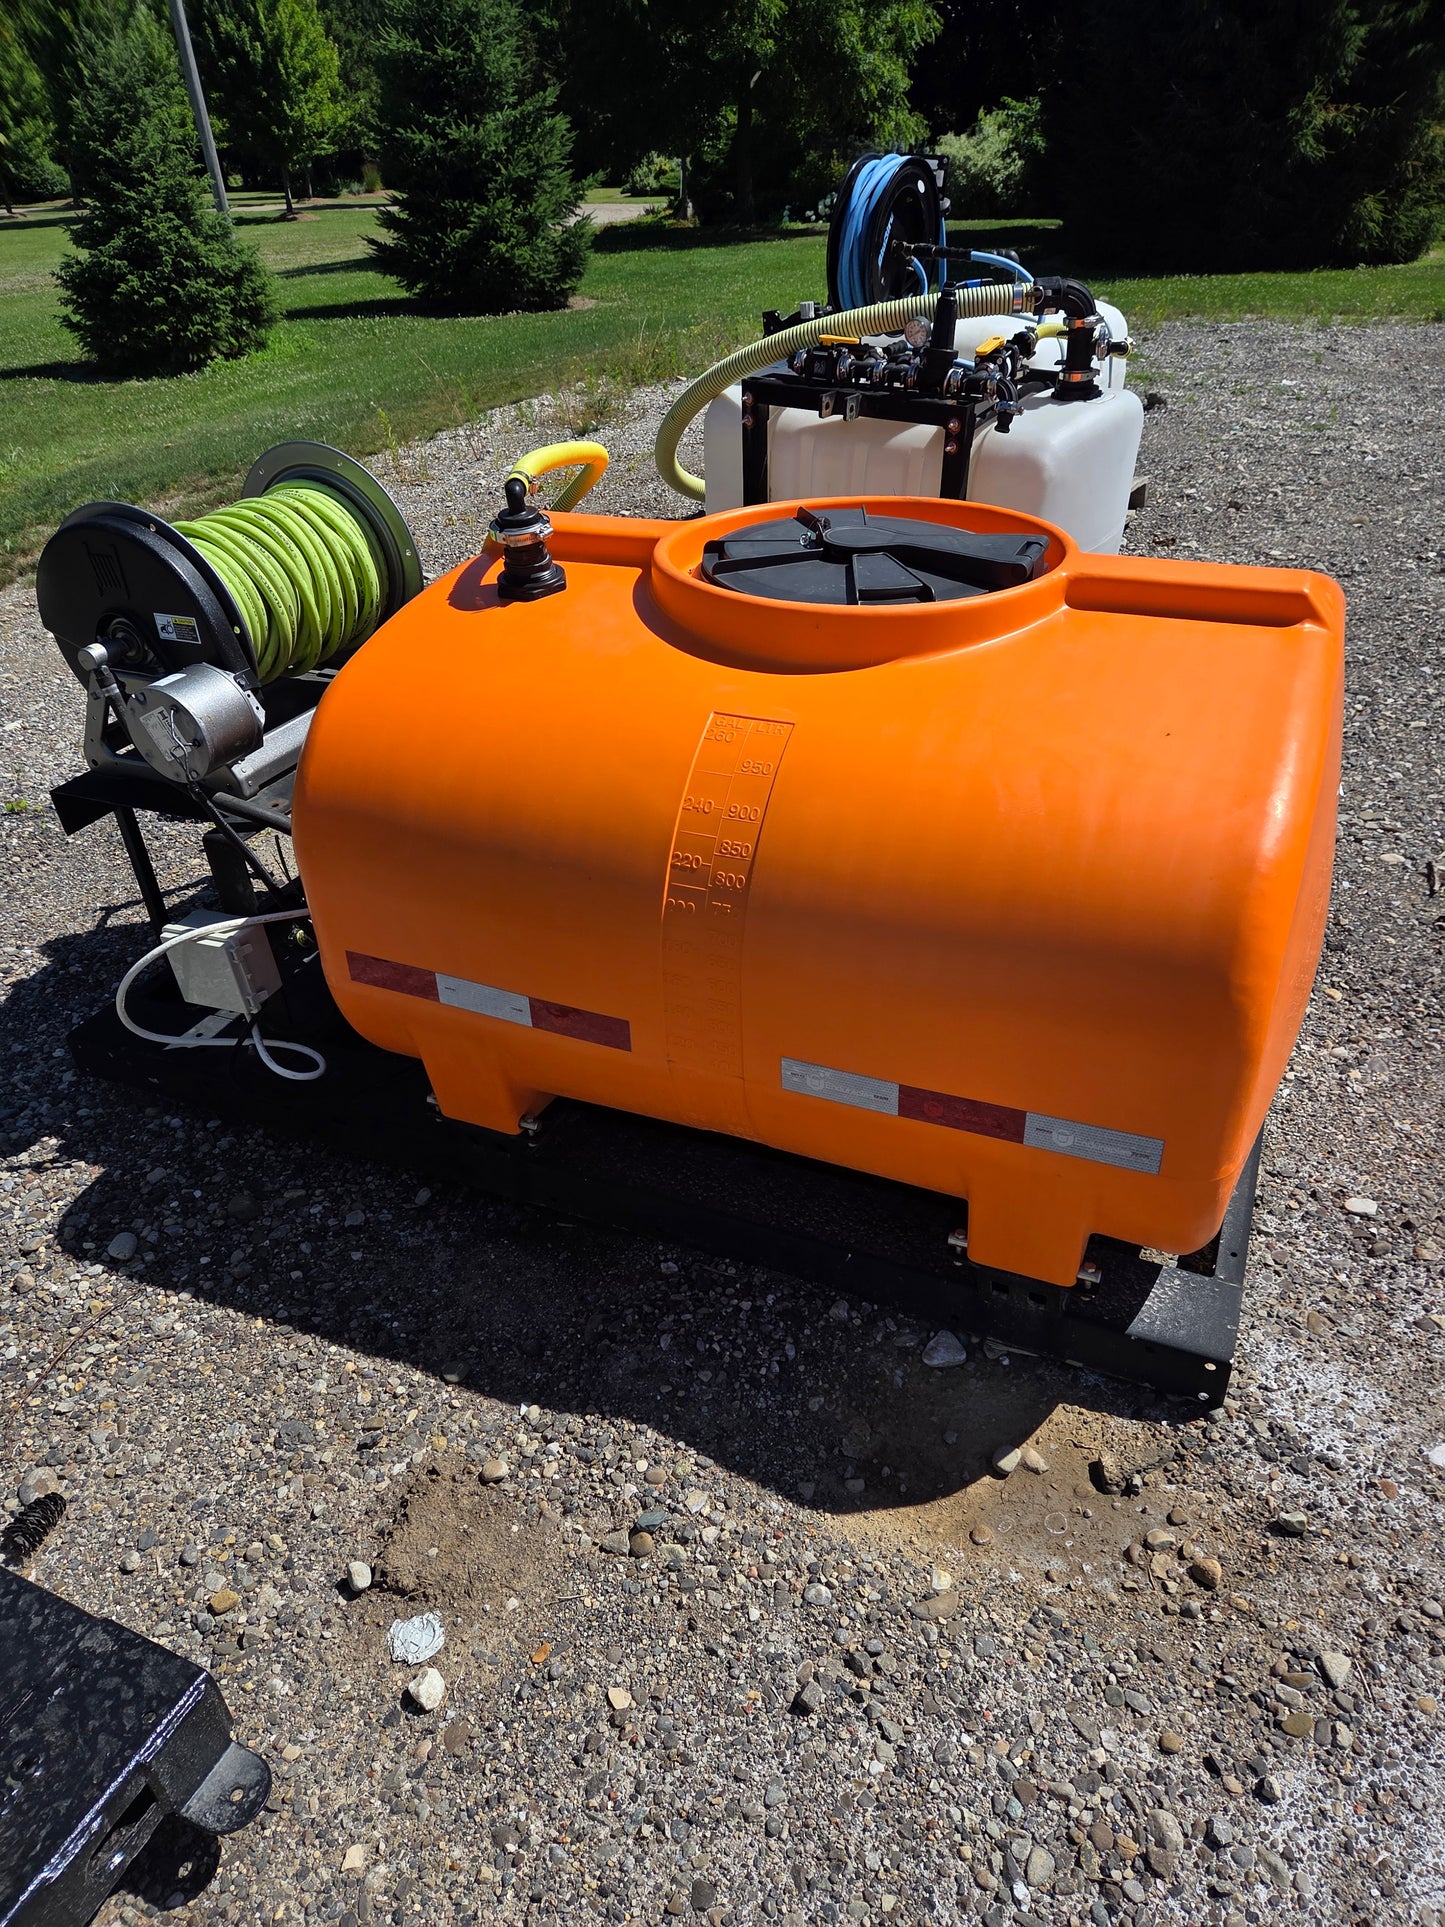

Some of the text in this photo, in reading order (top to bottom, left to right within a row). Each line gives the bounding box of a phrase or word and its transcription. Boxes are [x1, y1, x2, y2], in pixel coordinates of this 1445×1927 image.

[714, 716, 785, 736] GAL LTR
[703, 728, 737, 744] 260
[740, 759, 774, 776] 950
[681, 795, 715, 815] 240
[728, 803, 760, 821] 900
[720, 839, 752, 858] 850
[671, 851, 702, 871] 220
[714, 871, 746, 889] 800
